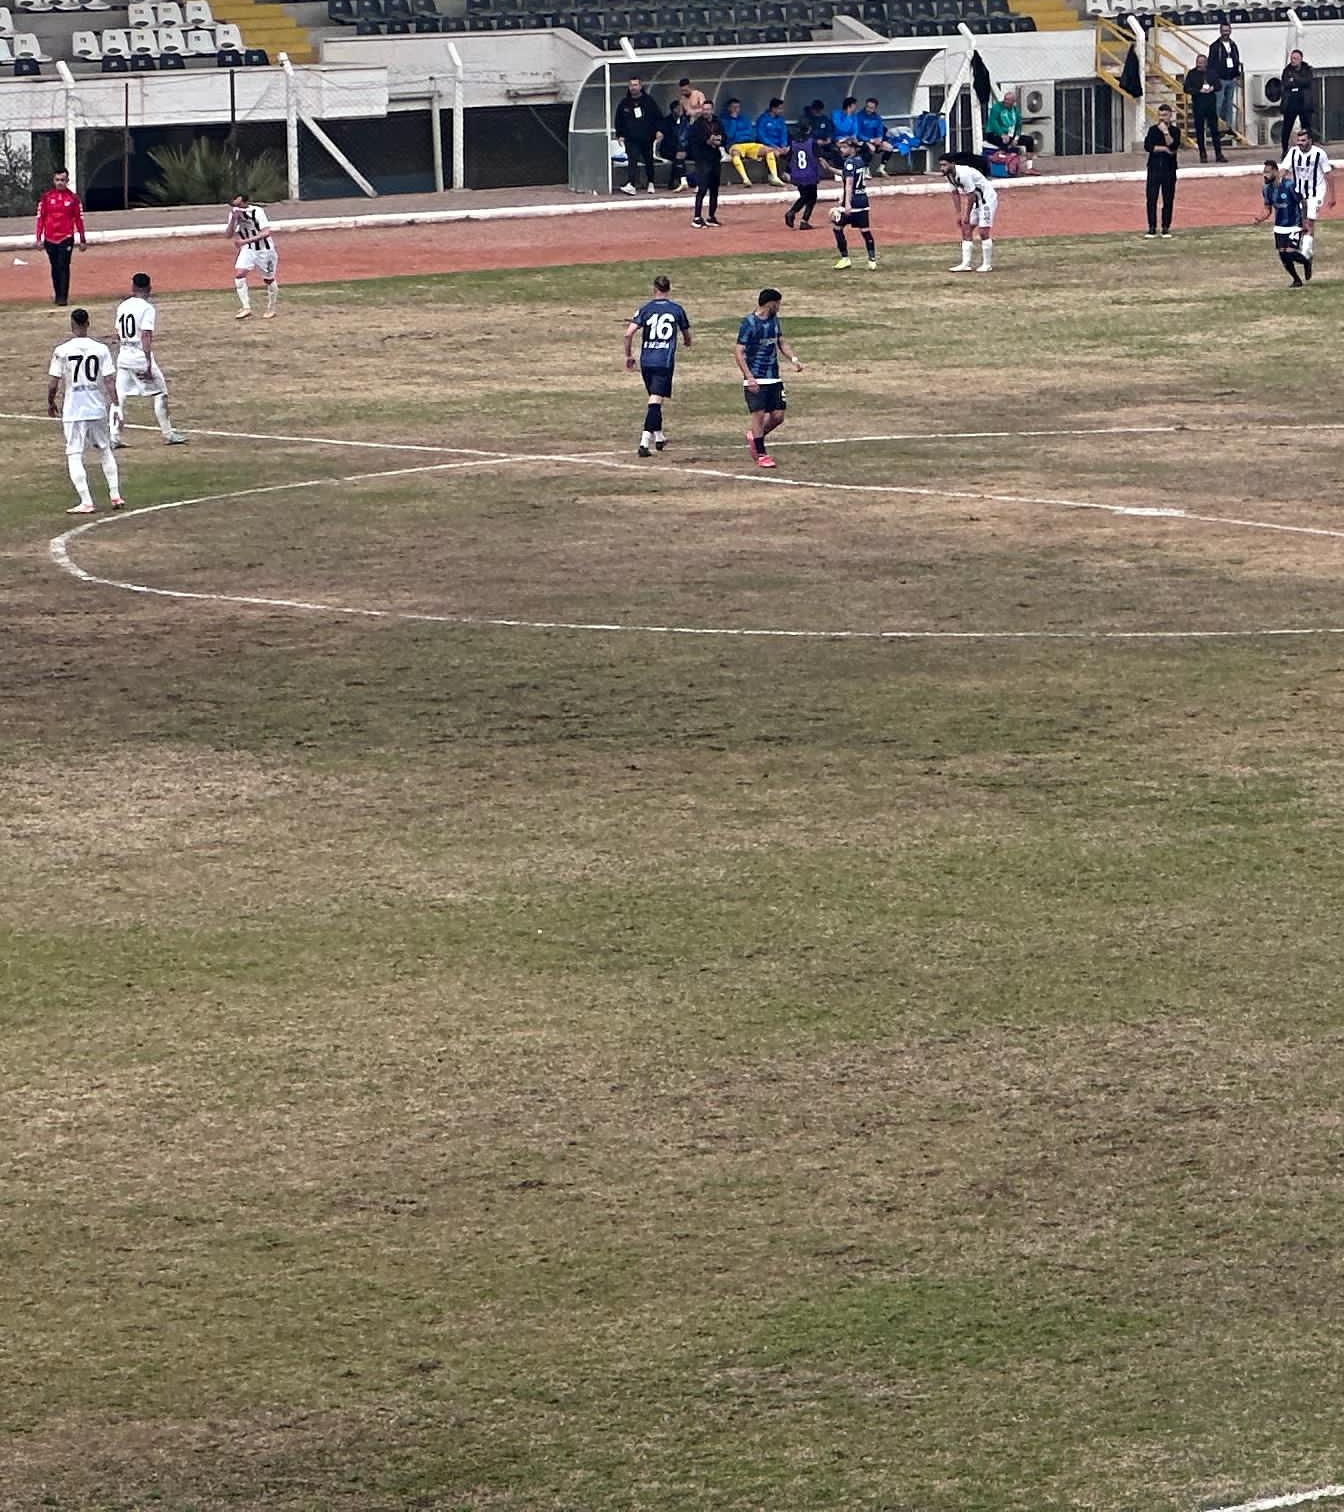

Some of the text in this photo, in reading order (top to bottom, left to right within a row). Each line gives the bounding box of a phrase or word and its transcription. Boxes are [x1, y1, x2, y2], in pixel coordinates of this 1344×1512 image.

[797, 150, 808, 169] 8
[118, 313, 136, 339] 10
[646, 312, 676, 340] 16
[67, 354, 100, 383] 70
